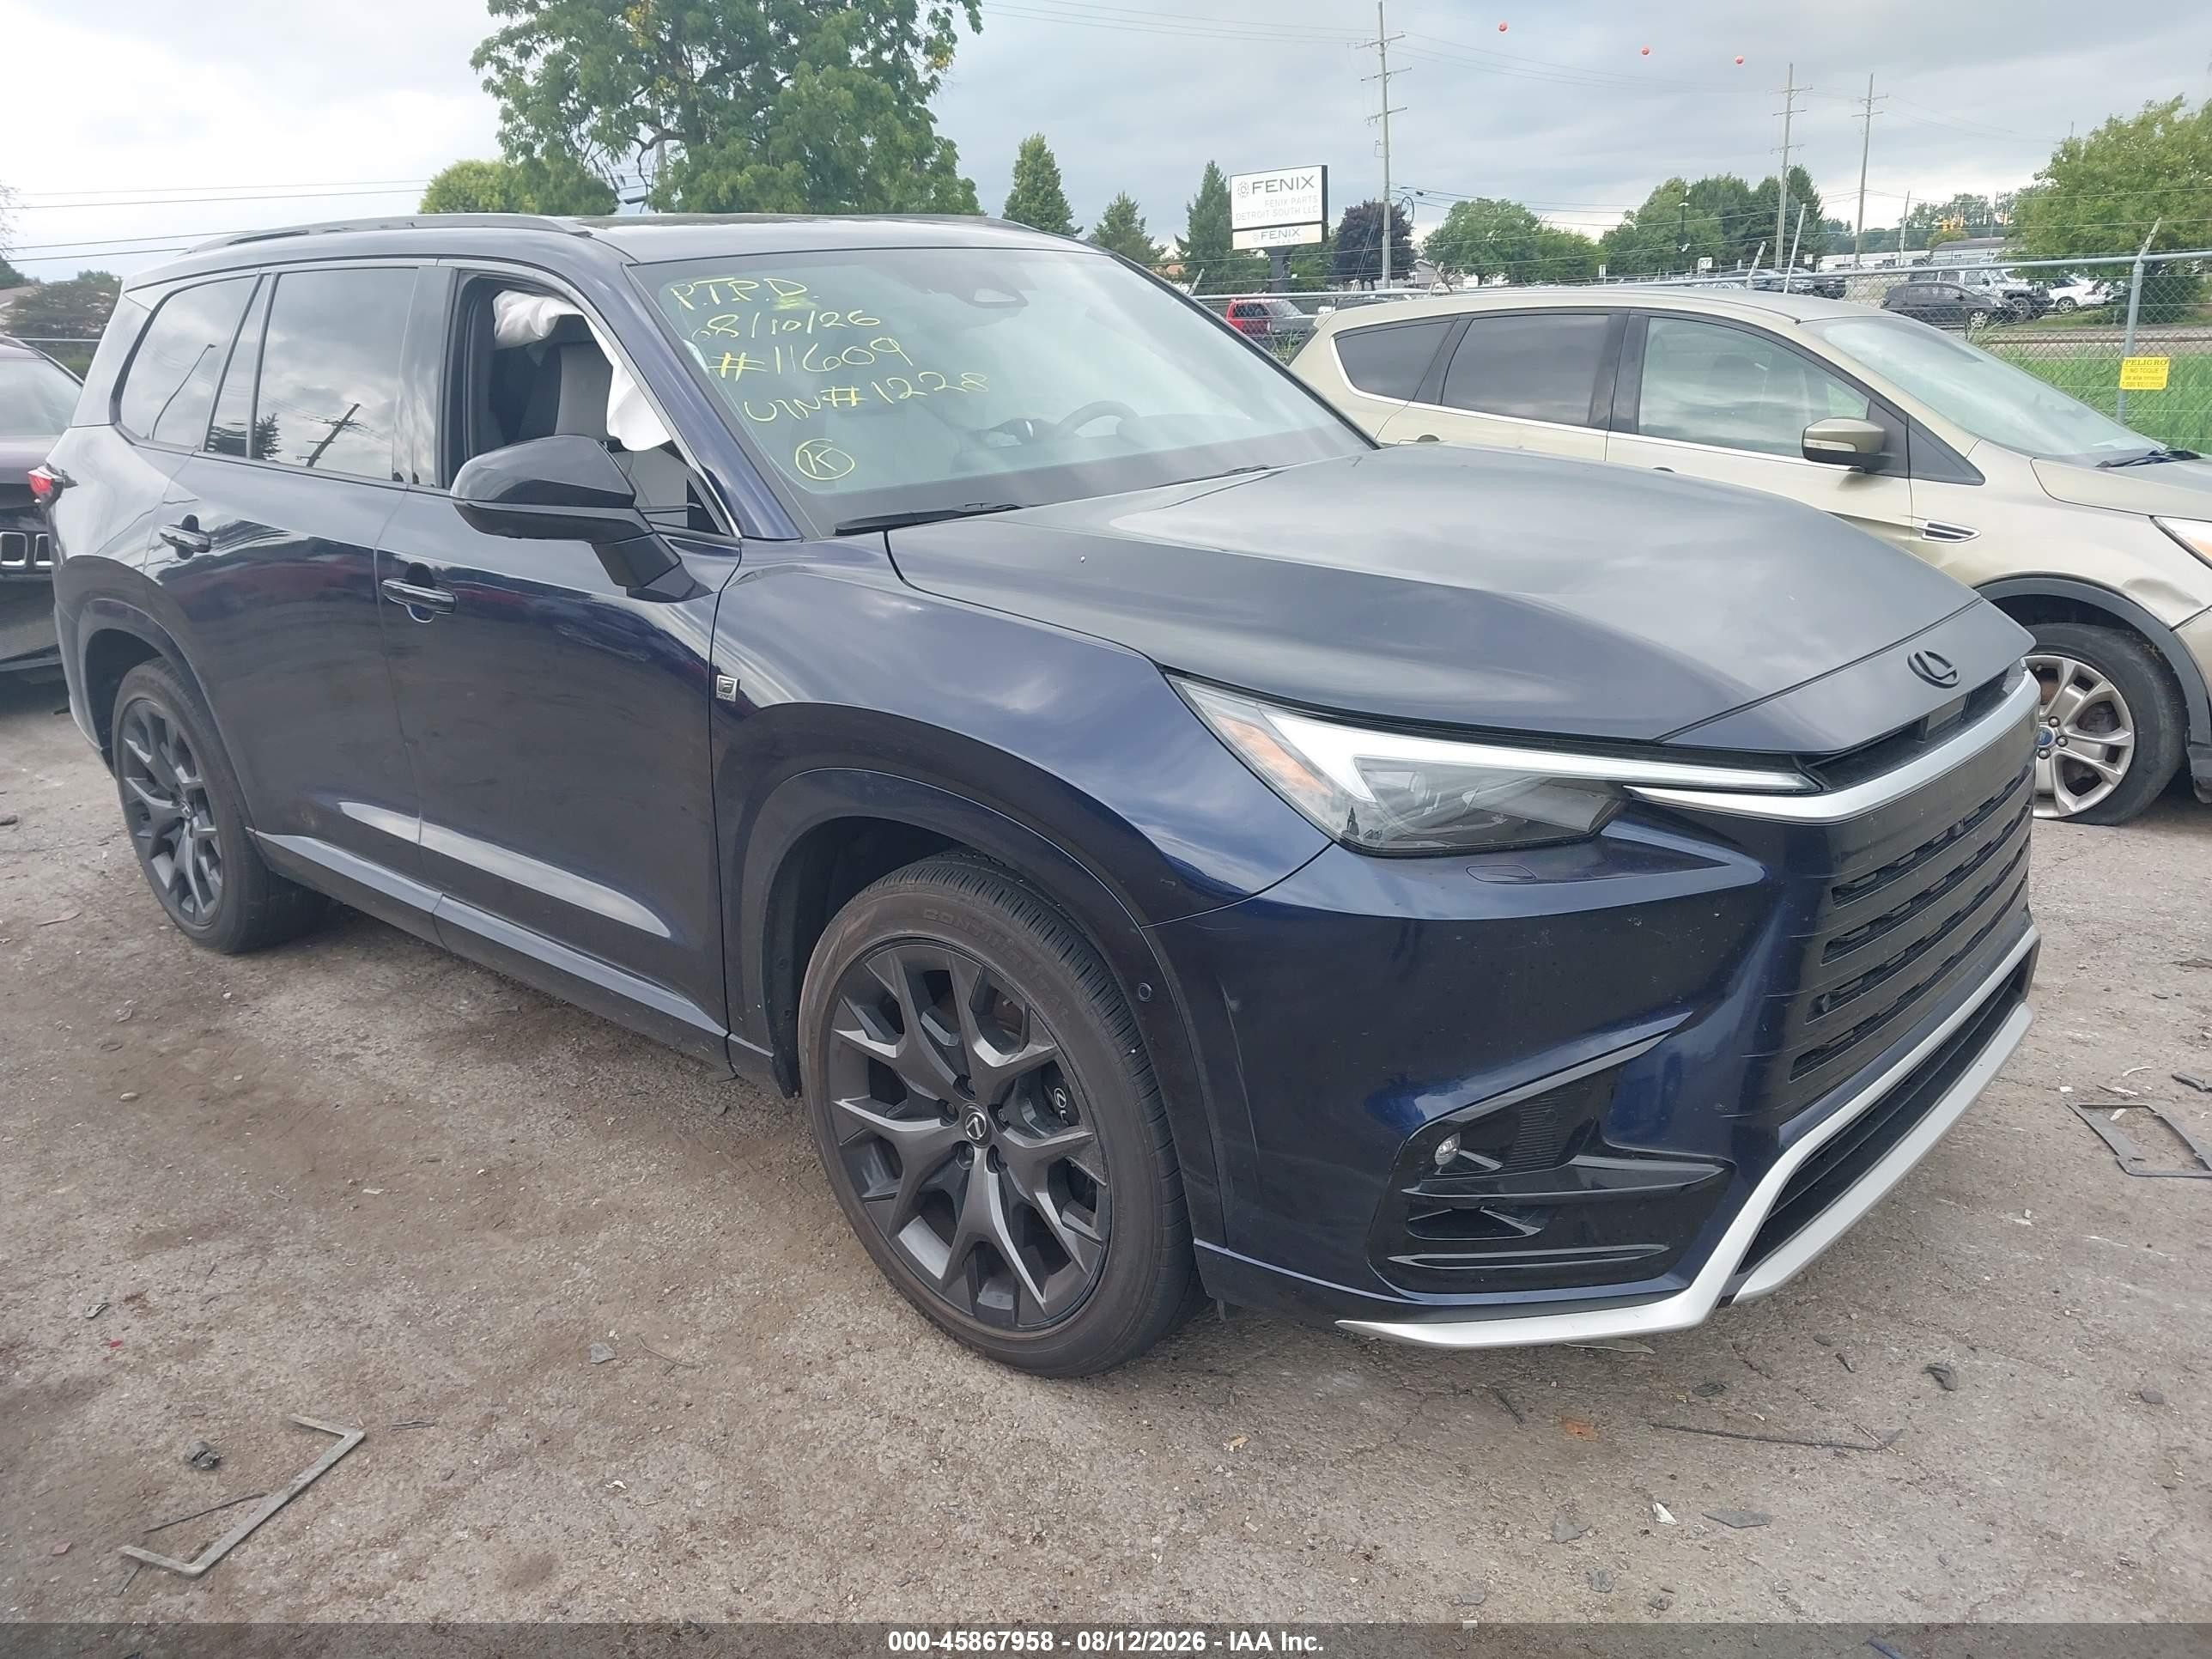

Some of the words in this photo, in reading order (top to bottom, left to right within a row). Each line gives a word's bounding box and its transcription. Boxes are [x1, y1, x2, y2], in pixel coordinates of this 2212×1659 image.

[1252, 175, 1315, 195] FENIX
[1264, 198, 1288, 208] FENIX
[1291, 195, 1318, 204] PARTS
[1236, 210, 1270, 221] DETROIT
[1273, 207, 1300, 217] SOUTH
[1303, 205, 1318, 214] LLC
[1261, 228, 1300, 240] FENIX
